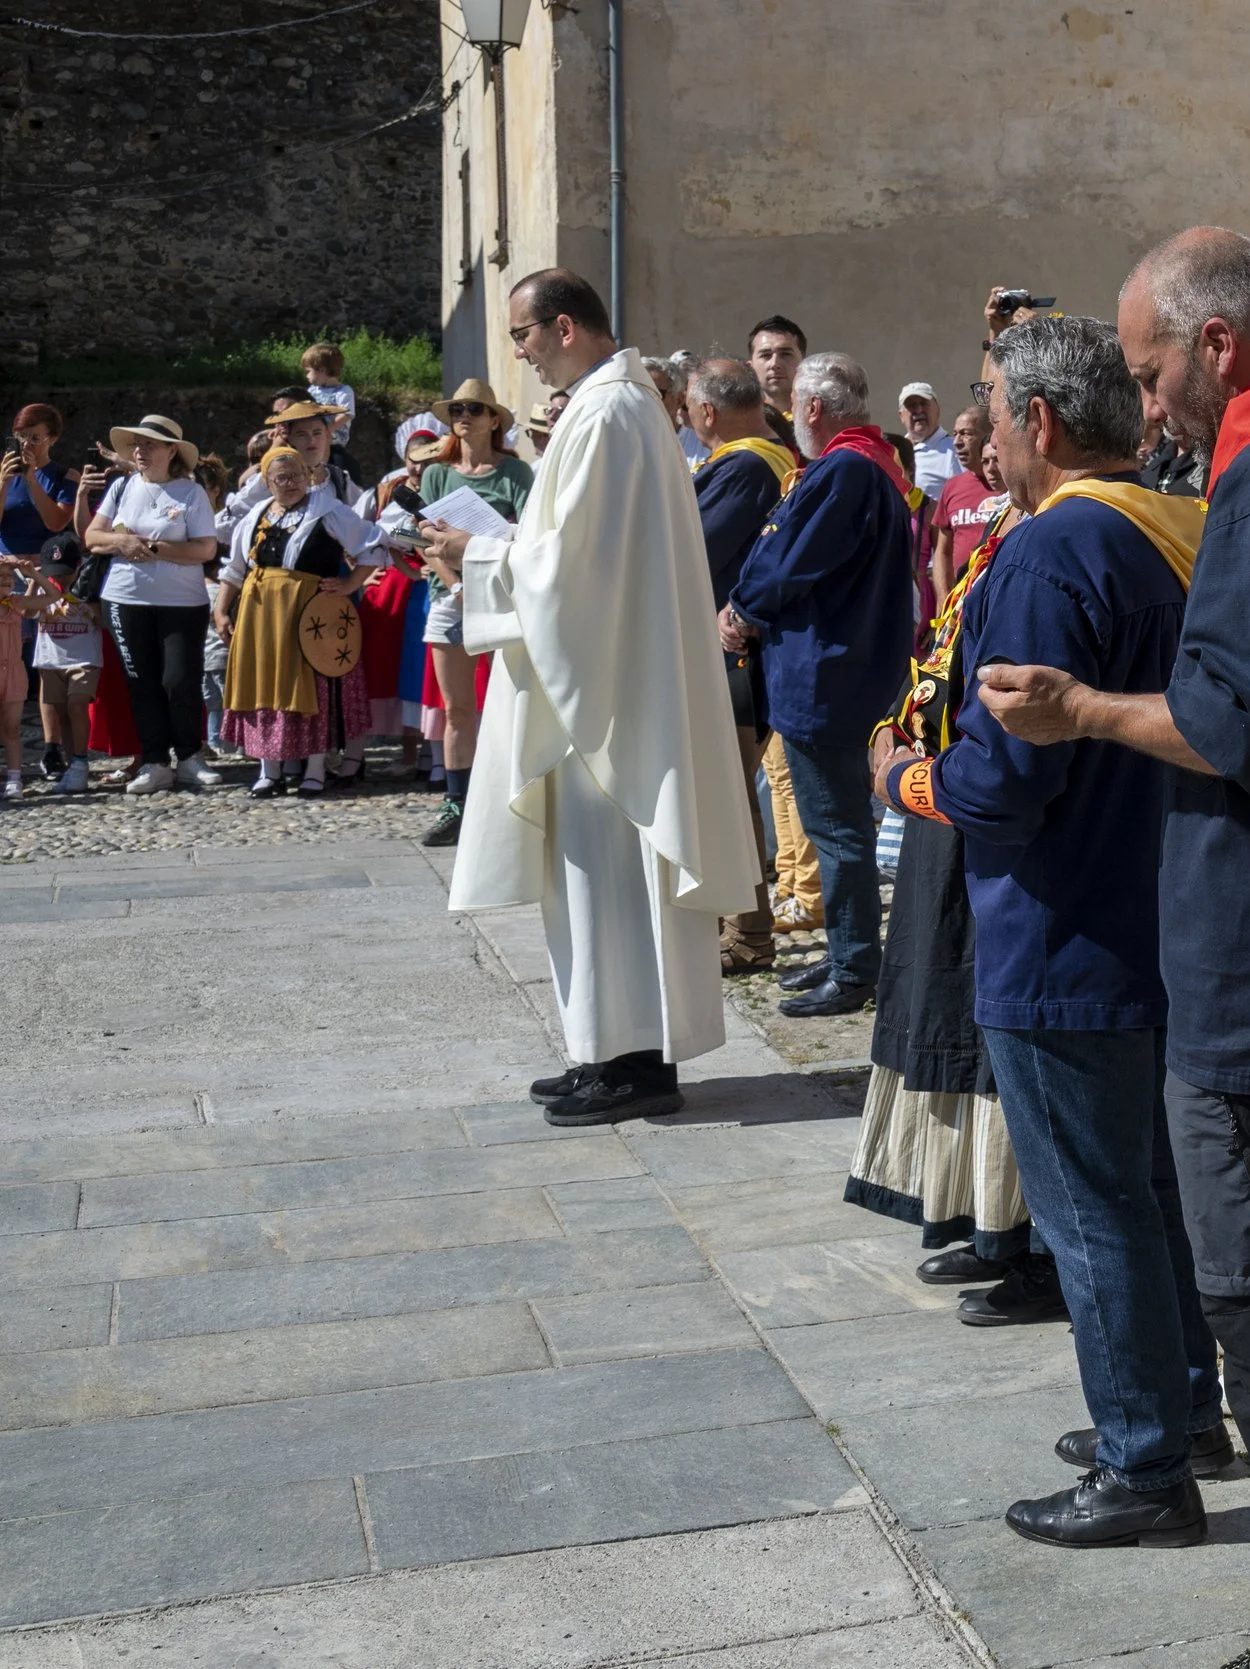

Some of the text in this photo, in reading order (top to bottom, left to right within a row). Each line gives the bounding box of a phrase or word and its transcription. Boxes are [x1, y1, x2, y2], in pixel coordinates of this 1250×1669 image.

[951, 508, 993, 526] elles
[110, 602, 139, 678] NICE LA BELLE
